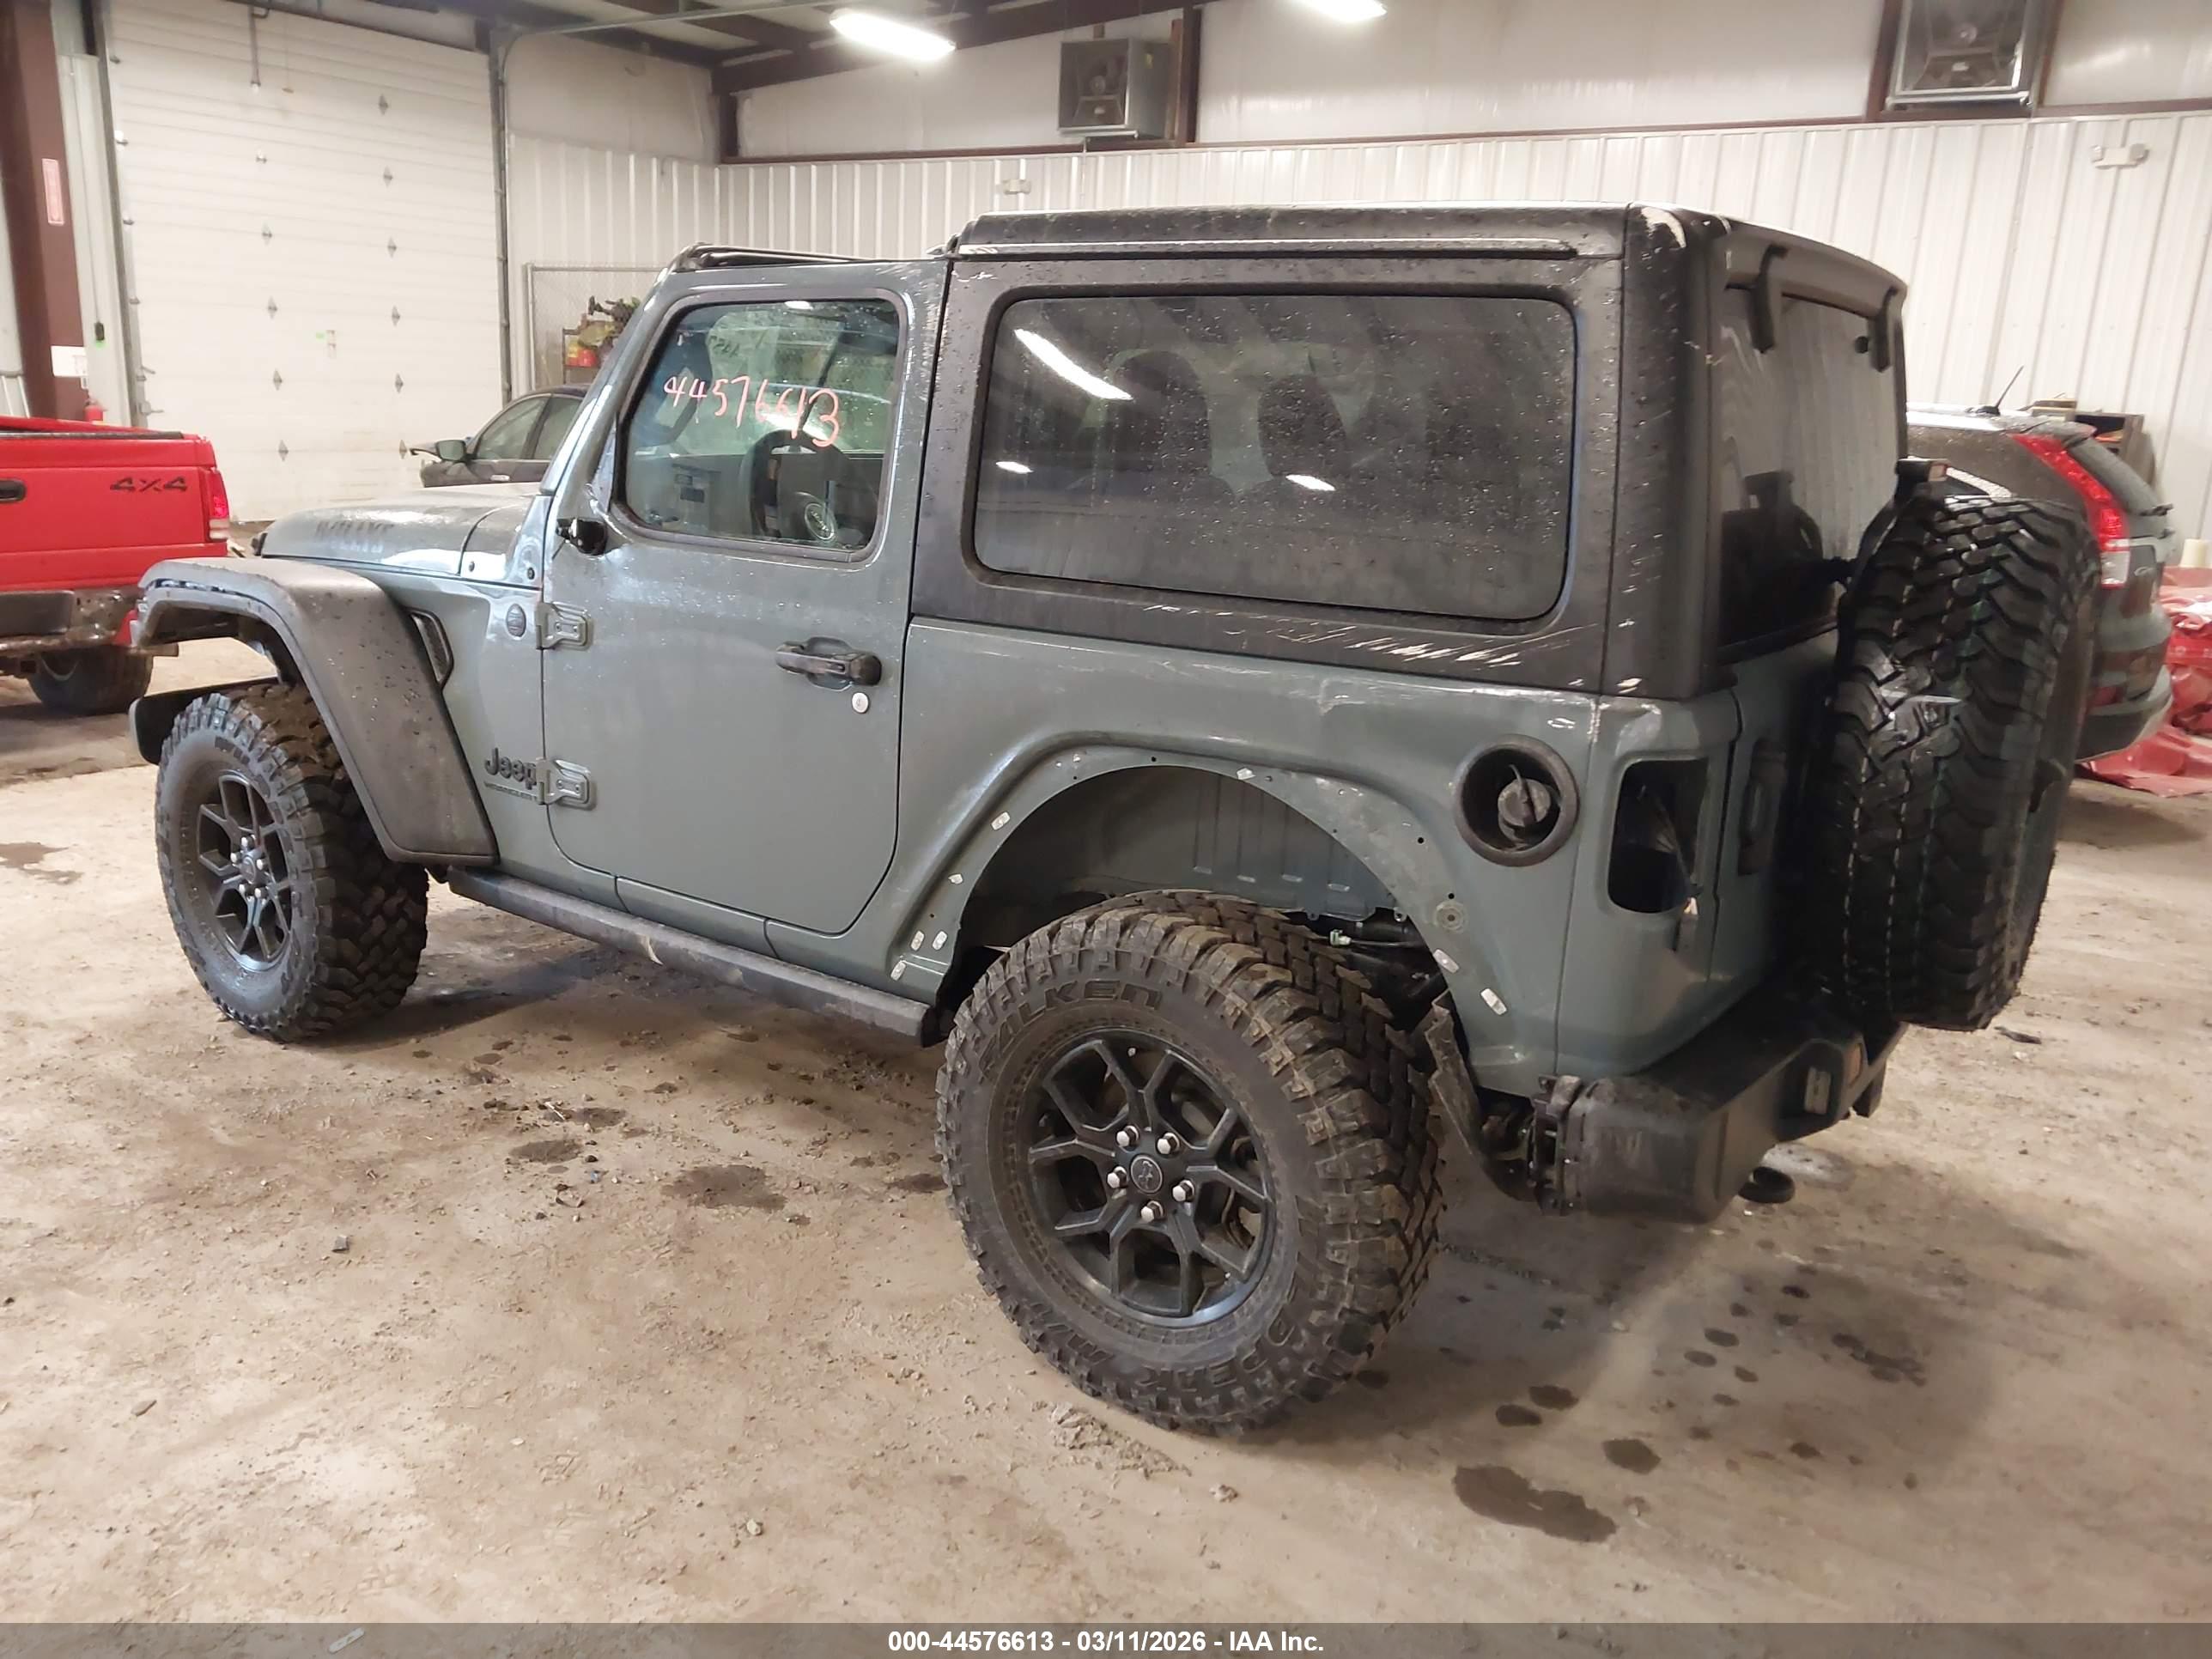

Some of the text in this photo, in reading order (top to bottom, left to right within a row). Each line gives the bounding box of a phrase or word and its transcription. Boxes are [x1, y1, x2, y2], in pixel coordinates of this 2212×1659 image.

[664, 375, 840, 447] 44576613
[484, 747, 538, 791] Jeep
[978, 979, 1162, 1084] FALKEN
